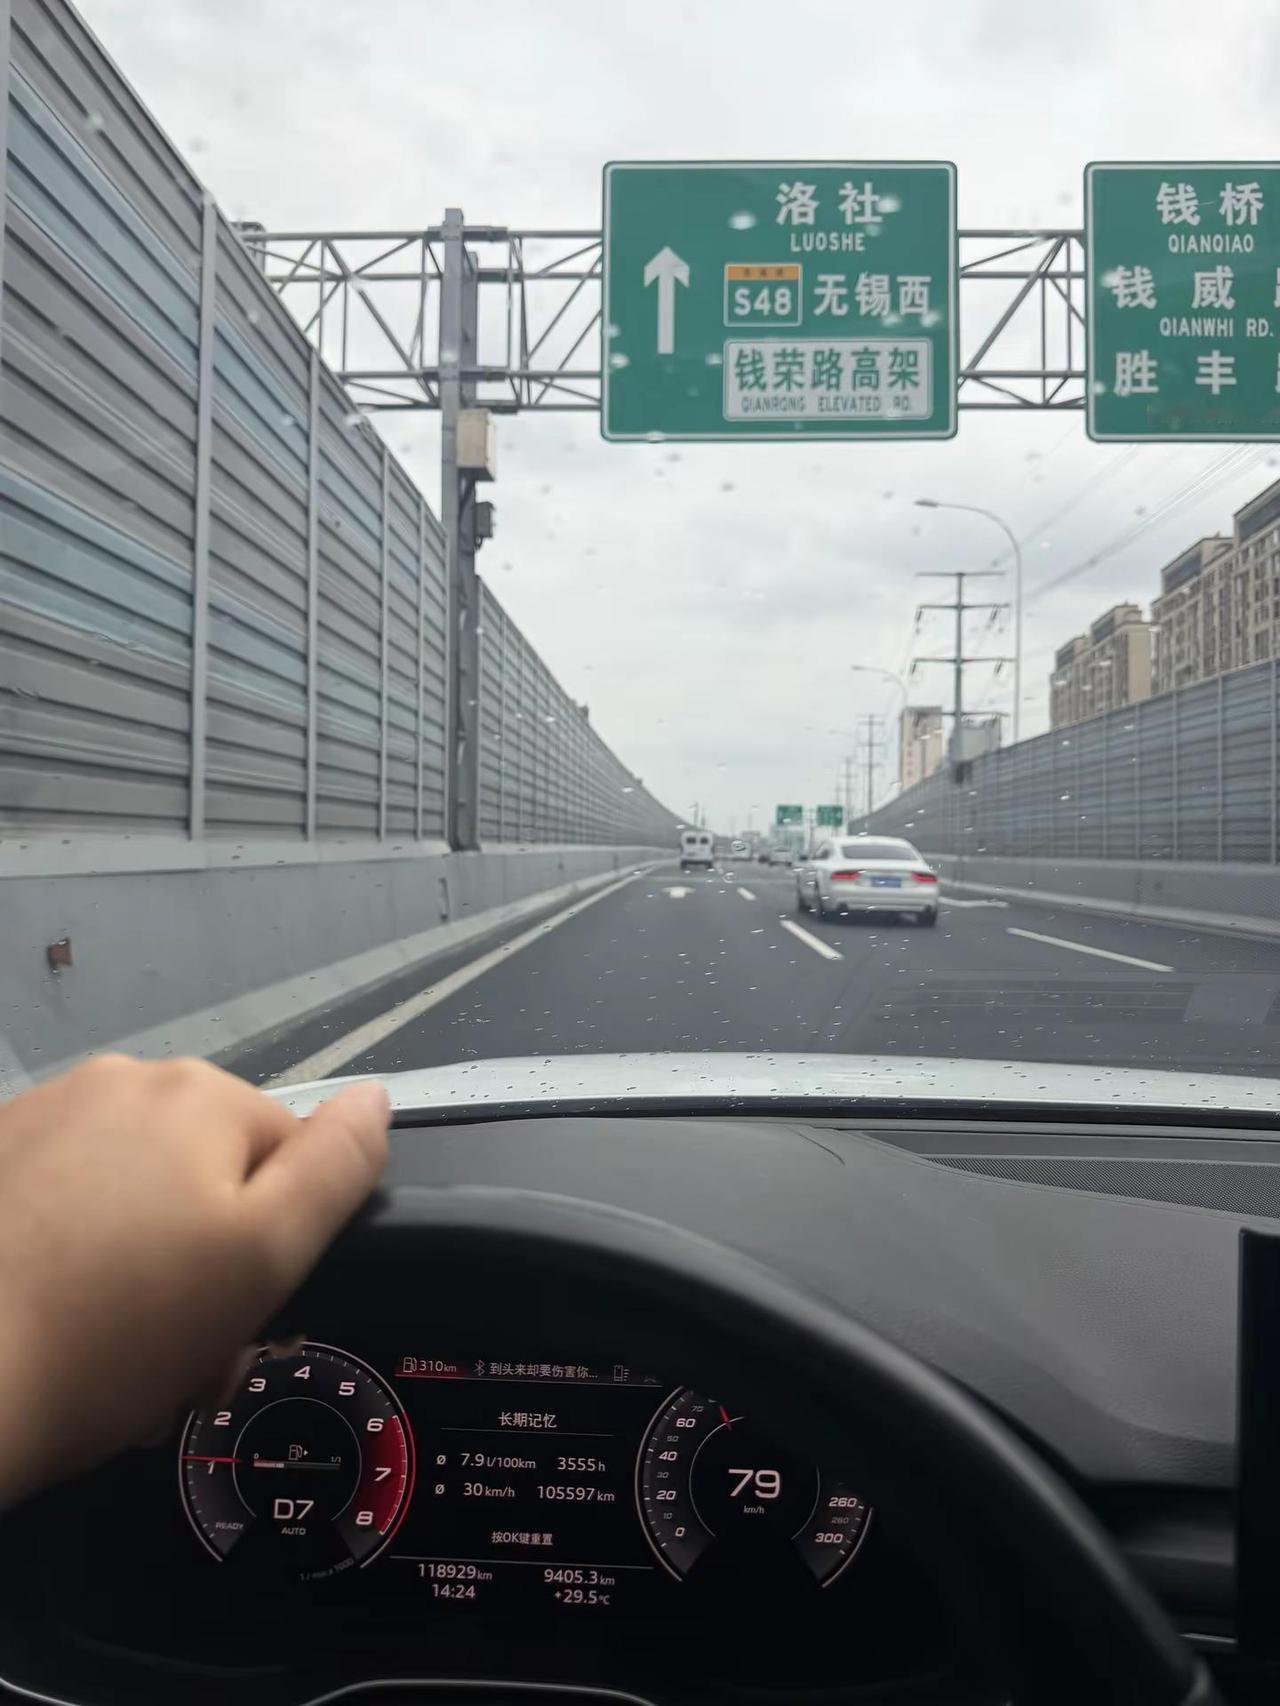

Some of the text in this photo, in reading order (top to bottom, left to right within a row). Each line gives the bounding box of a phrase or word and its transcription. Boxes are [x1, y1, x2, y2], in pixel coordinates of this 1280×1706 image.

[776, 182, 882, 225] 洛社
[1156, 182, 1264, 226] 钱桥
[791, 233, 865, 252] LUOSHE
[1168, 234, 1254, 253] QIANQIAO
[813, 272, 932, 317] 无锡西
[1112, 265, 1280, 310] 钱威
[734, 288, 792, 316] S48
[1247, 319, 1274, 337] RD.
[734, 347, 920, 392] 钱荣路高架
[1113, 350, 1280, 396] 胜丰
[818, 396, 881, 413] ELEVATED
[294, 1366, 311, 1380] 4
[419, 1360, 457, 1373] 310km
[249, 1378, 266, 1392] 3
[338, 1382, 356, 1396] 5
[214, 1412, 232, 1426] 2
[366, 1418, 384, 1433] 6
[498, 1412, 558, 1429] 长期记忆
[676, 1418, 696, 1428] 60
[659, 1452, 678, 1461] 40
[374, 1467, 391, 1482] 7
[728, 1468, 781, 1498] 79
[656, 1490, 676, 1500] 20
[829, 1497, 857, 1507] 260
[273, 1499, 314, 1520] D7
[743, 1505, 765, 1514] km/h
[355, 1511, 373, 1525] 8
[215, 1522, 244, 1531] READY
[281, 1526, 306, 1536] AUTO
[675, 1527, 685, 1537] 0
[490, 1532, 553, 1546] 按OK键重置
[815, 1533, 843, 1543] 300
[432, 1584, 476, 1599] 14:24
